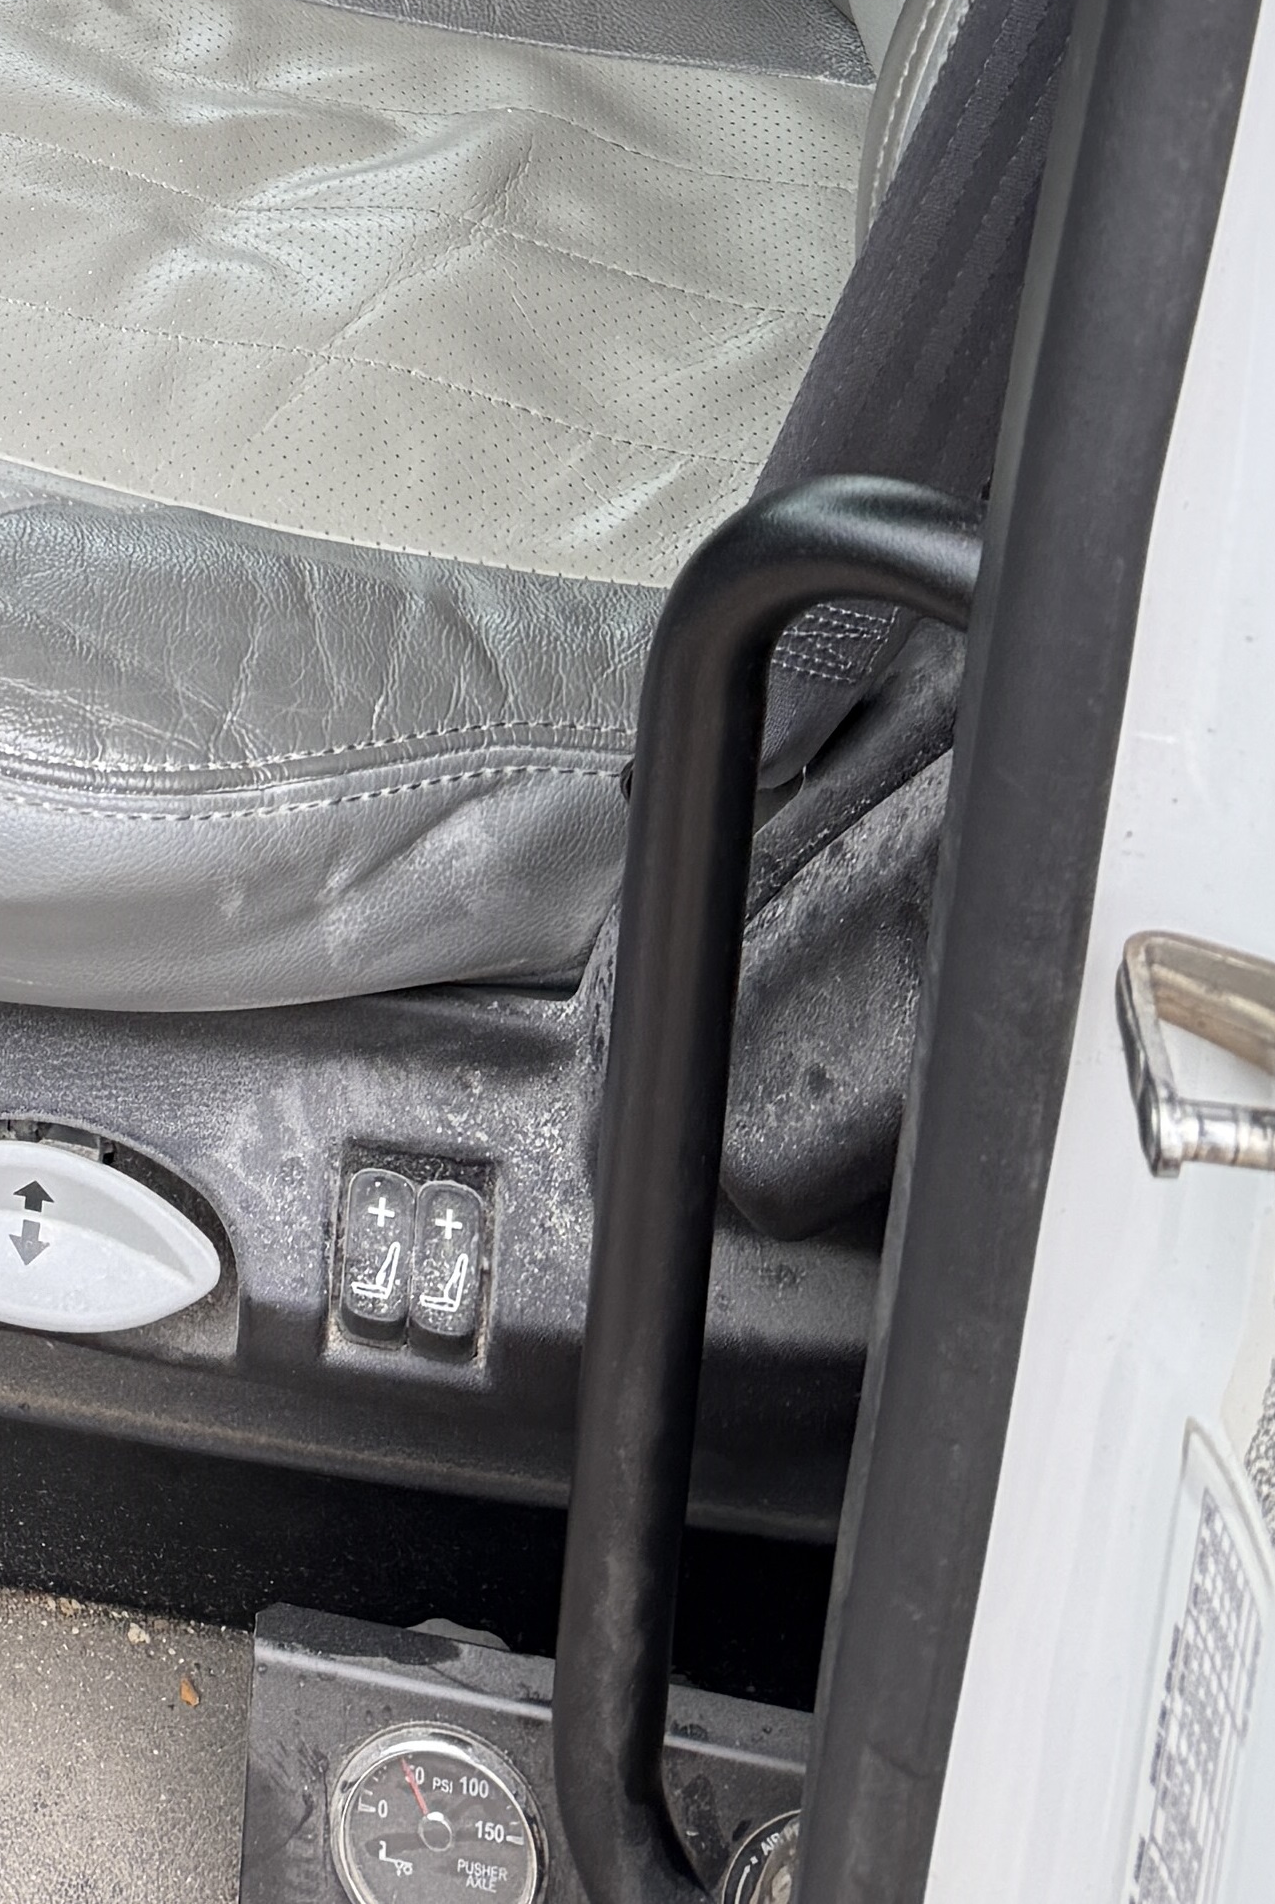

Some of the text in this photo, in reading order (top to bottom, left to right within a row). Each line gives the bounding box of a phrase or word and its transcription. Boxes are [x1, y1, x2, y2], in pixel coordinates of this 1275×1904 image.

[432, 1777, 453, 1793] PSI
[459, 1776, 489, 1799] 100
[378, 1799, 388, 1818] 0
[475, 1820, 505, 1843] 150
[457, 1858, 508, 1881] PUSHER
[466, 1876, 497, 1893] AXLE
